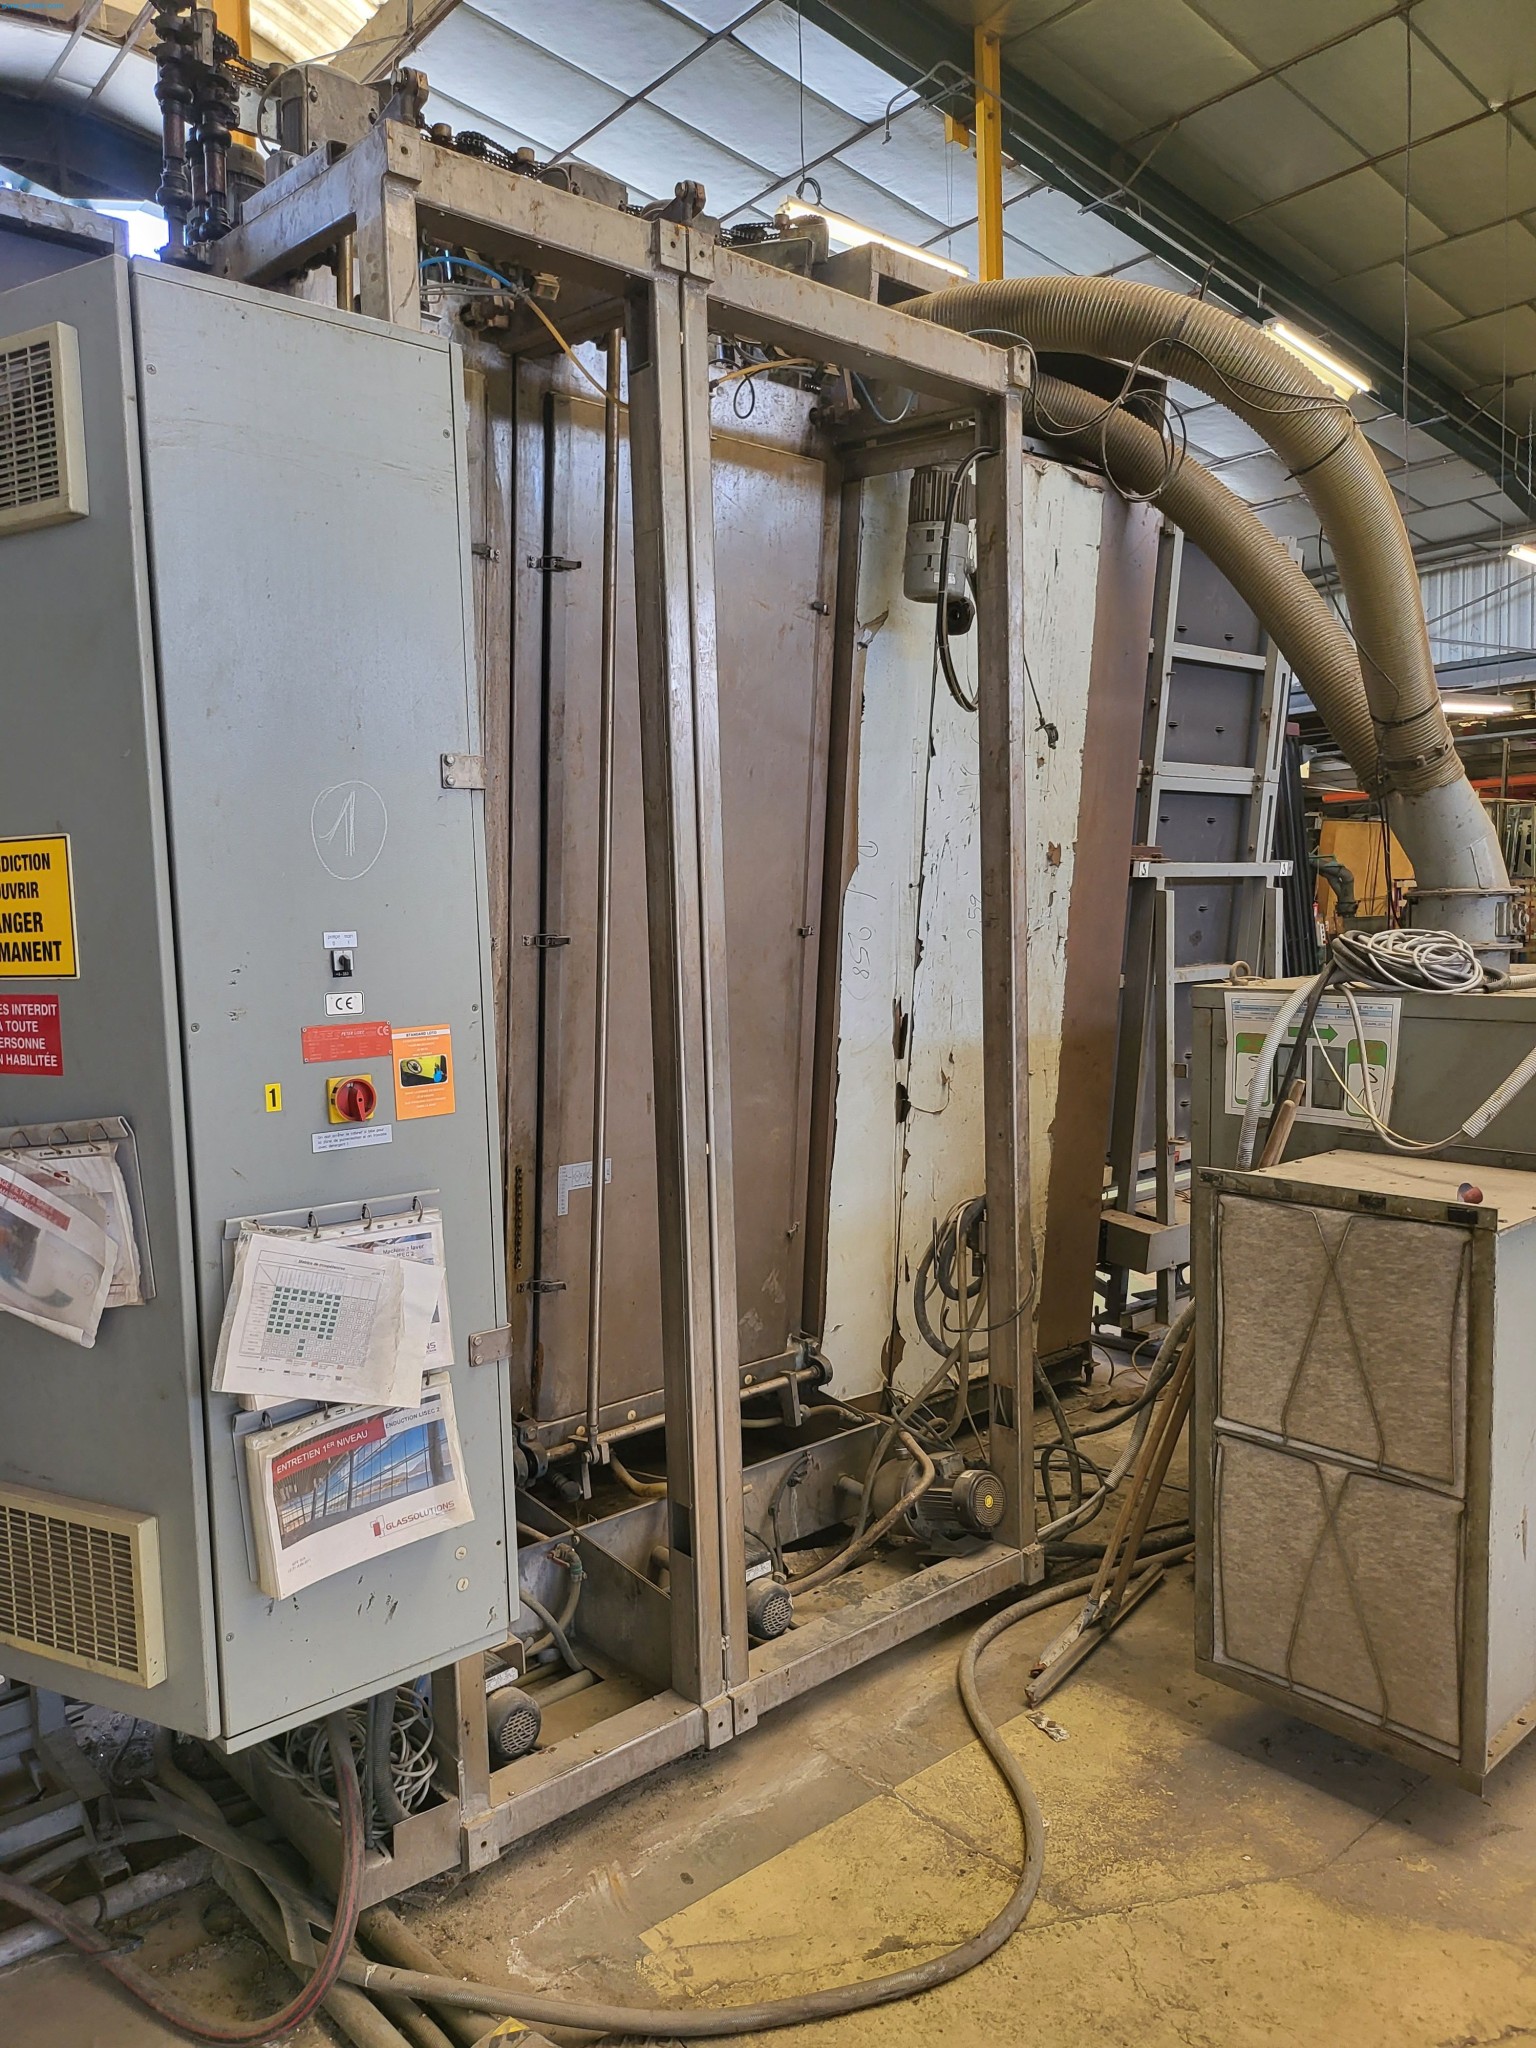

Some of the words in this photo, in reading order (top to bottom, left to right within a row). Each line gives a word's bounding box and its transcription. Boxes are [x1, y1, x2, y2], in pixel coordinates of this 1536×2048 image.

[0, 853, 51, 872] DICTION
[0, 881, 39, 900] UVRIR
[0, 911, 44, 934] NGER
[11, 1003, 58, 1016] INTERDIT
[335, 996, 354, 1011] CE
[5, 1020, 39, 1033] TOUTE
[377, 1026, 390, 1036] CE
[5, 1051, 58, 1067] HABILITÉE
[268, 1087, 277, 1108] 1
[385, 1413, 418, 1429] ENDUCTION
[276, 1447, 320, 1475] ENTRETIEN
[336, 1429, 369, 1449] NIVEAU
[385, 1500, 455, 1530] GLASSOLUTIONS
